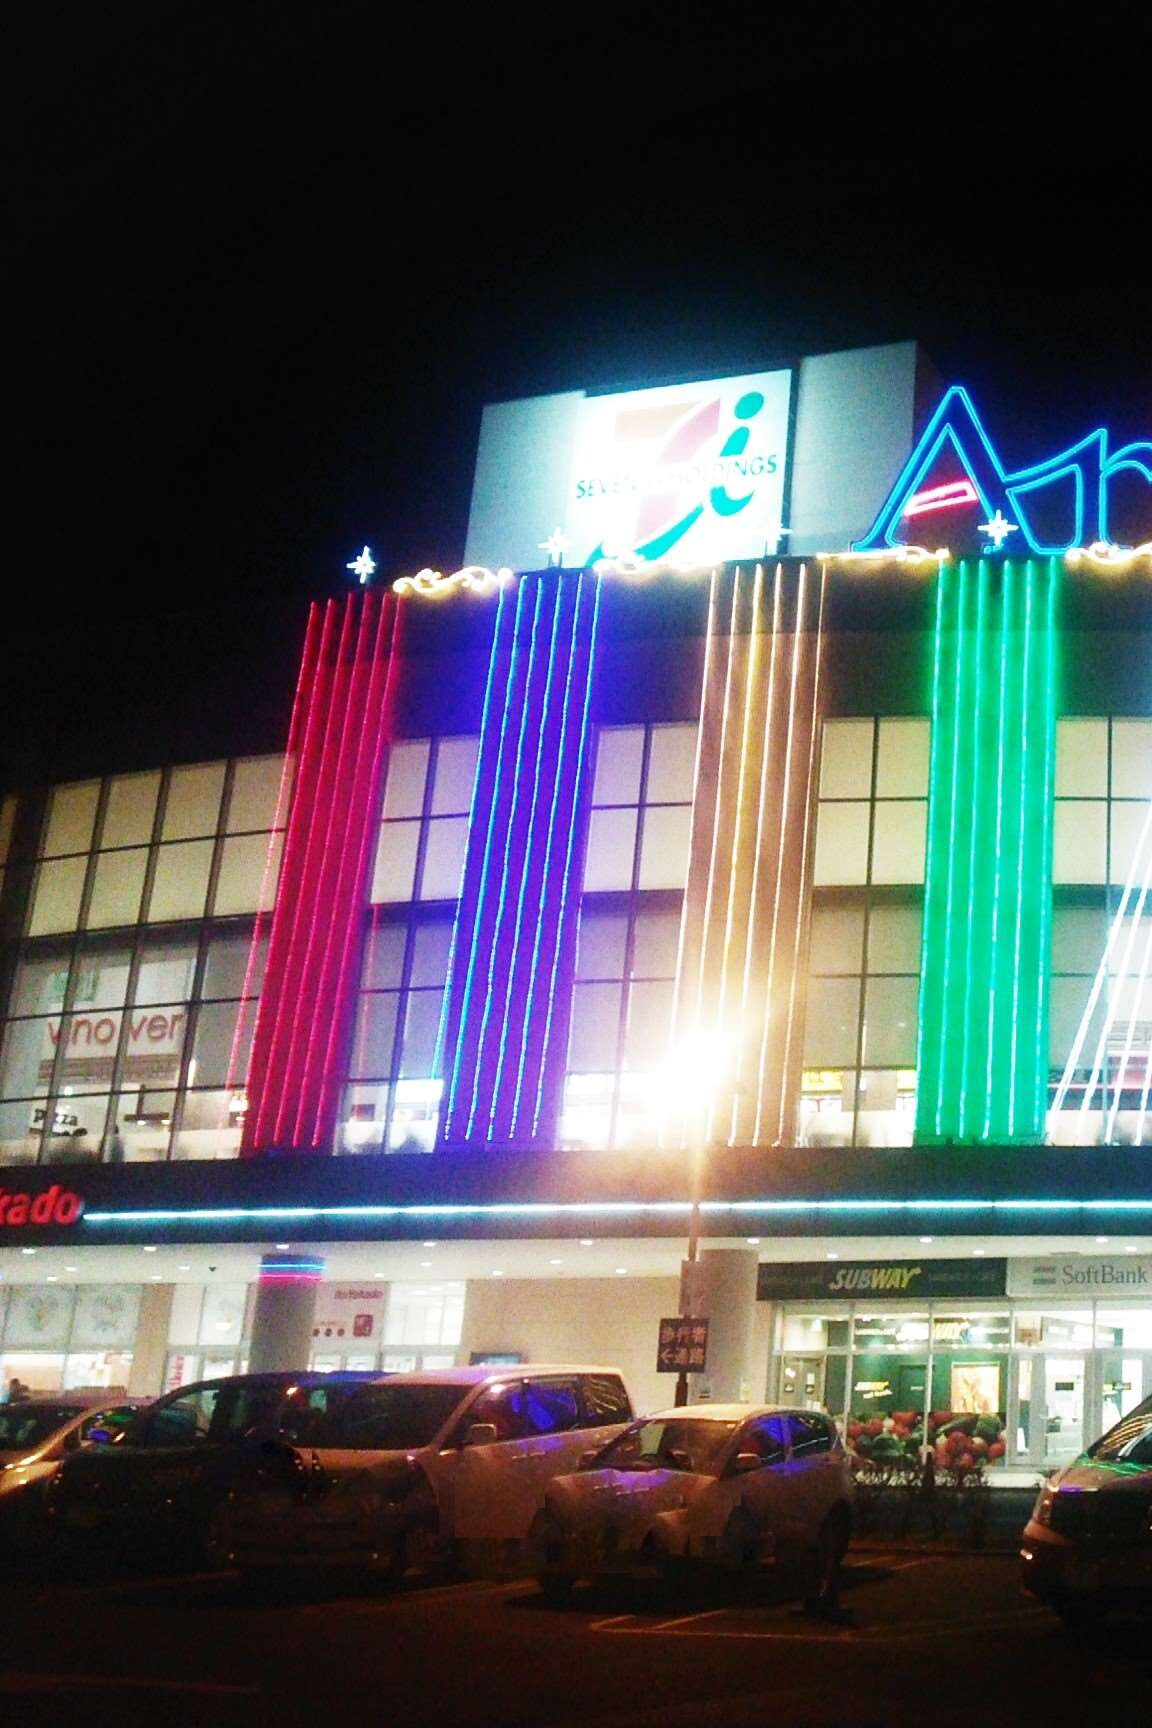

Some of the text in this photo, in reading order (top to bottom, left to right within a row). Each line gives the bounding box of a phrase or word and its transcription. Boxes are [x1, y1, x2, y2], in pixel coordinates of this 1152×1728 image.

[33, 1107, 79, 1127] pza
[828, 1267, 922, 1290] SUBWAY
[1062, 1264, 1149, 1285] SoftBank
